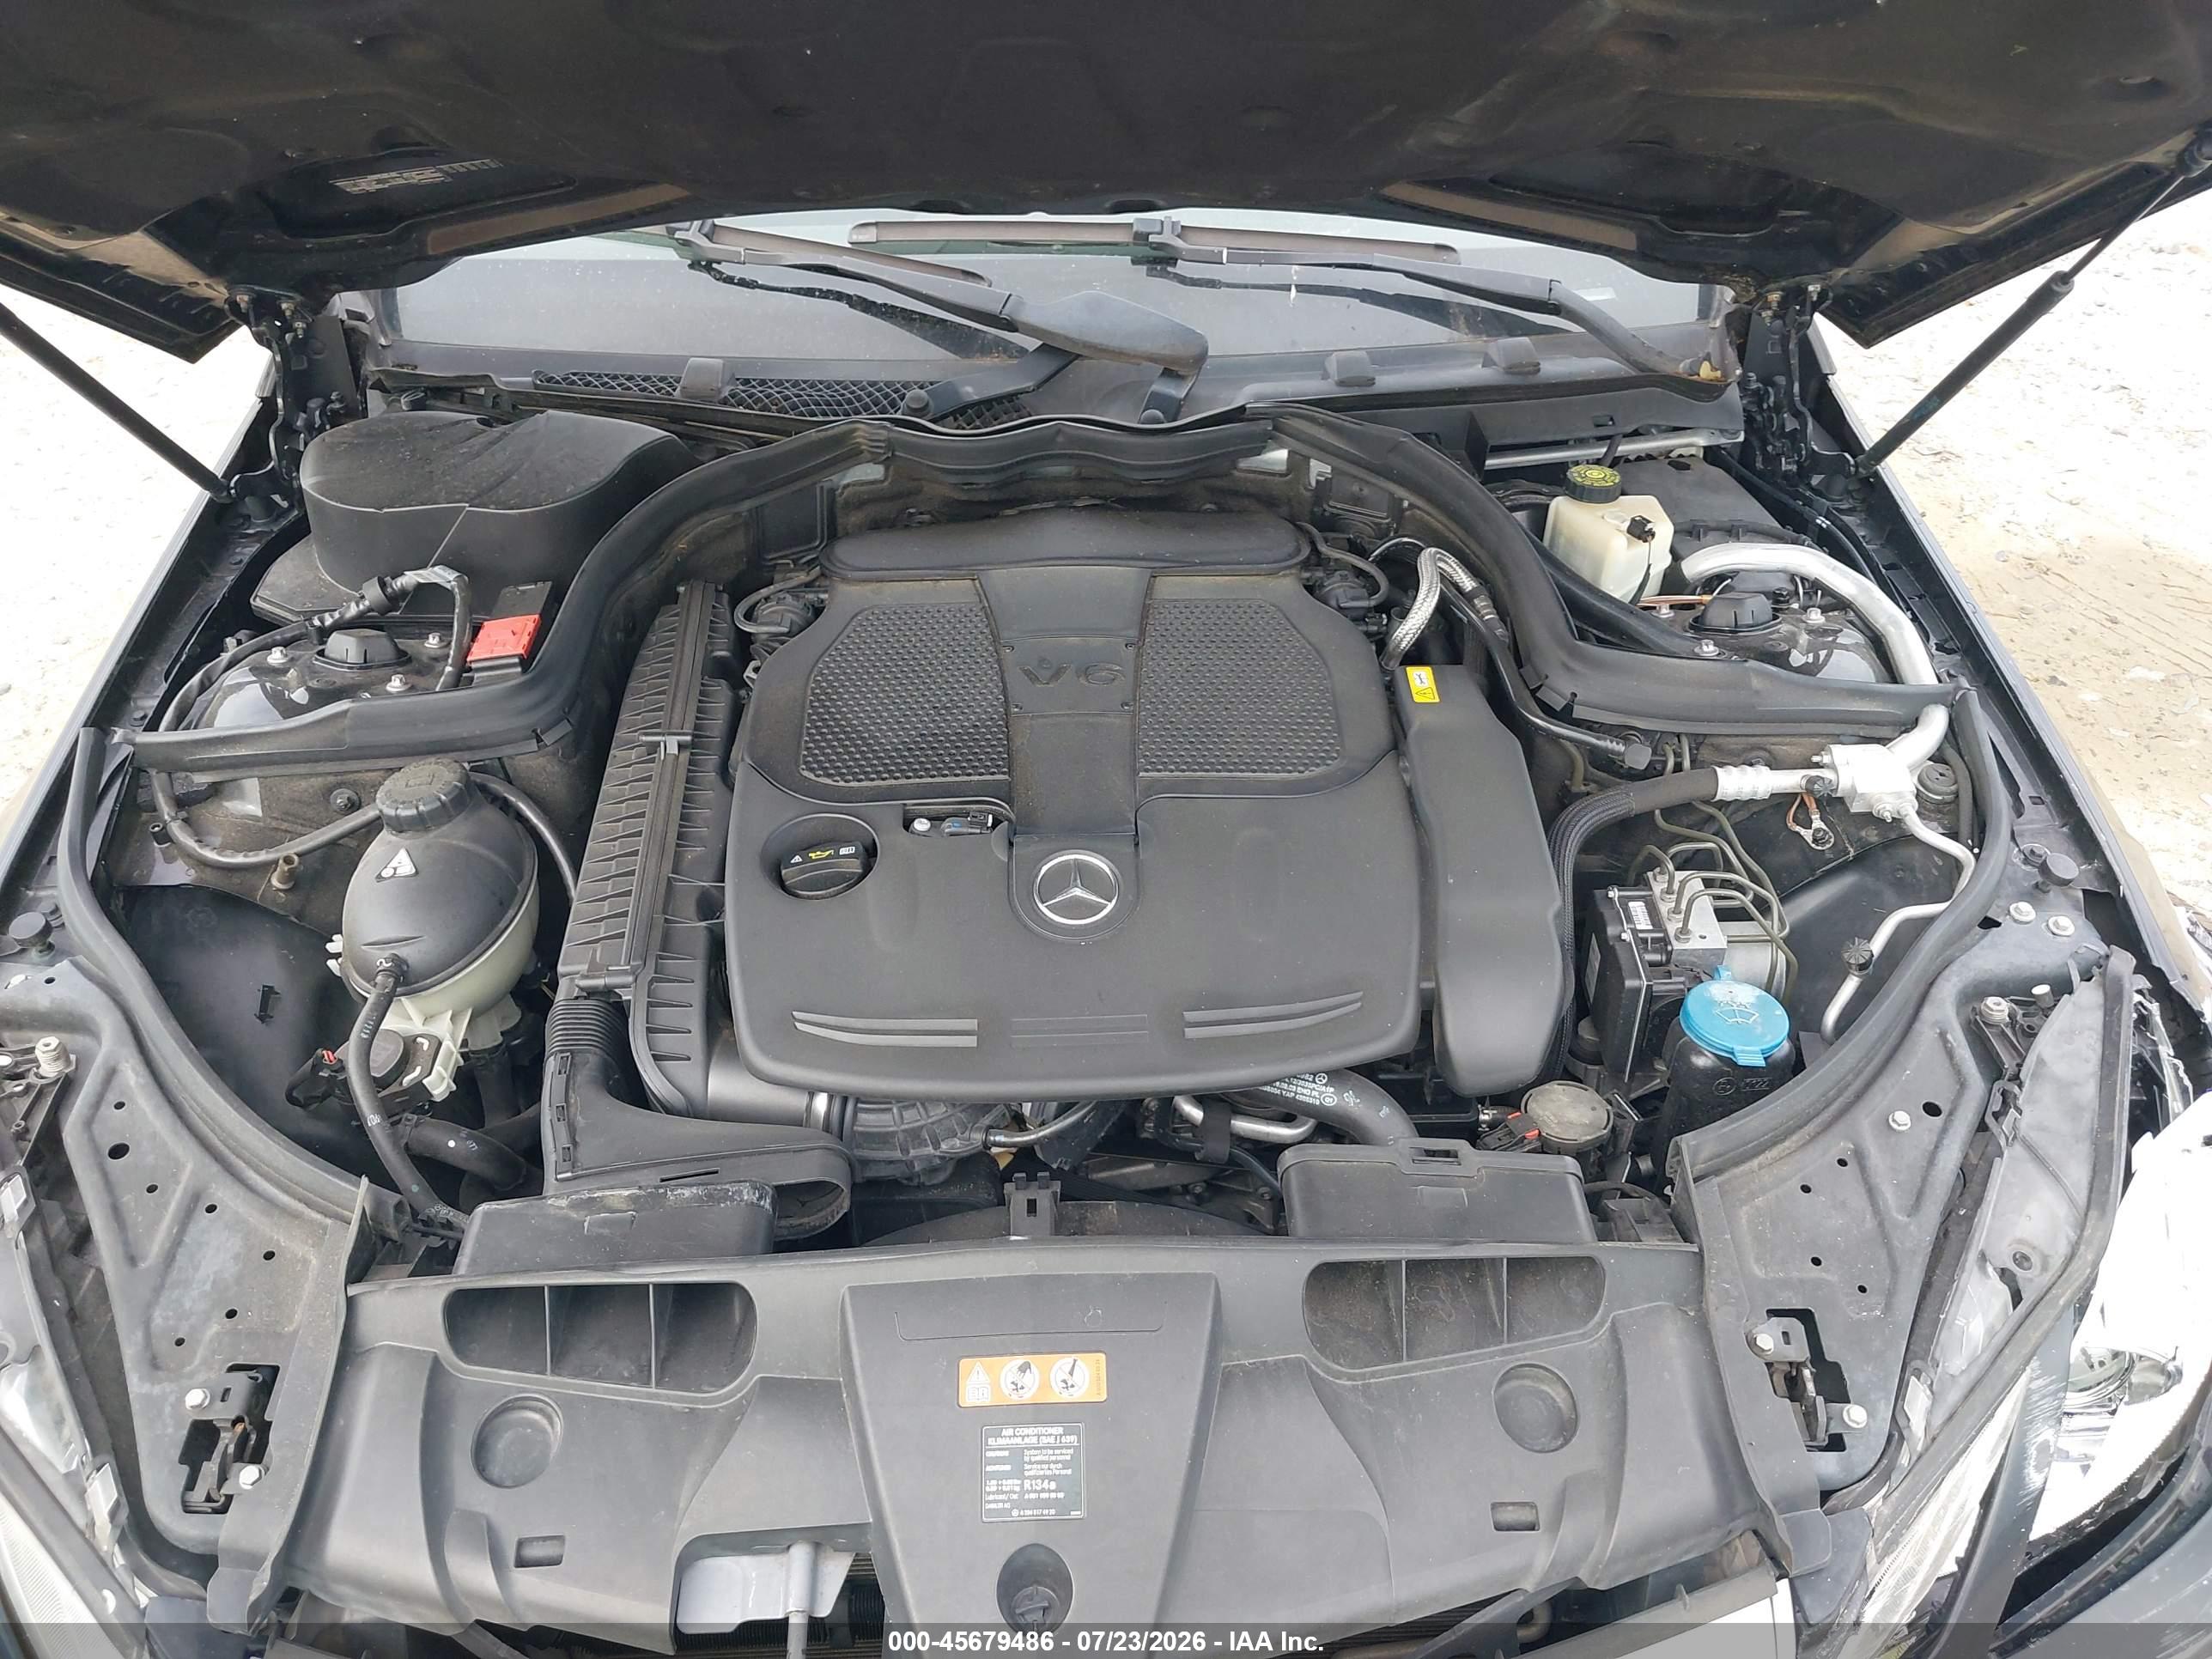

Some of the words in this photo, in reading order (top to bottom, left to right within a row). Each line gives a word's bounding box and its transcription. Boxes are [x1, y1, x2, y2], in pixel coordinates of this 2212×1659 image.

[1019, 662, 1126, 687] V6
[1001, 1428, 1013, 1437] AIR
[1015, 1427, 1064, 1436] CONDITIONER
[988, 1436, 1038, 1445] KLIMAANLAGE
[1024, 1479, 1056, 1491] R134a
